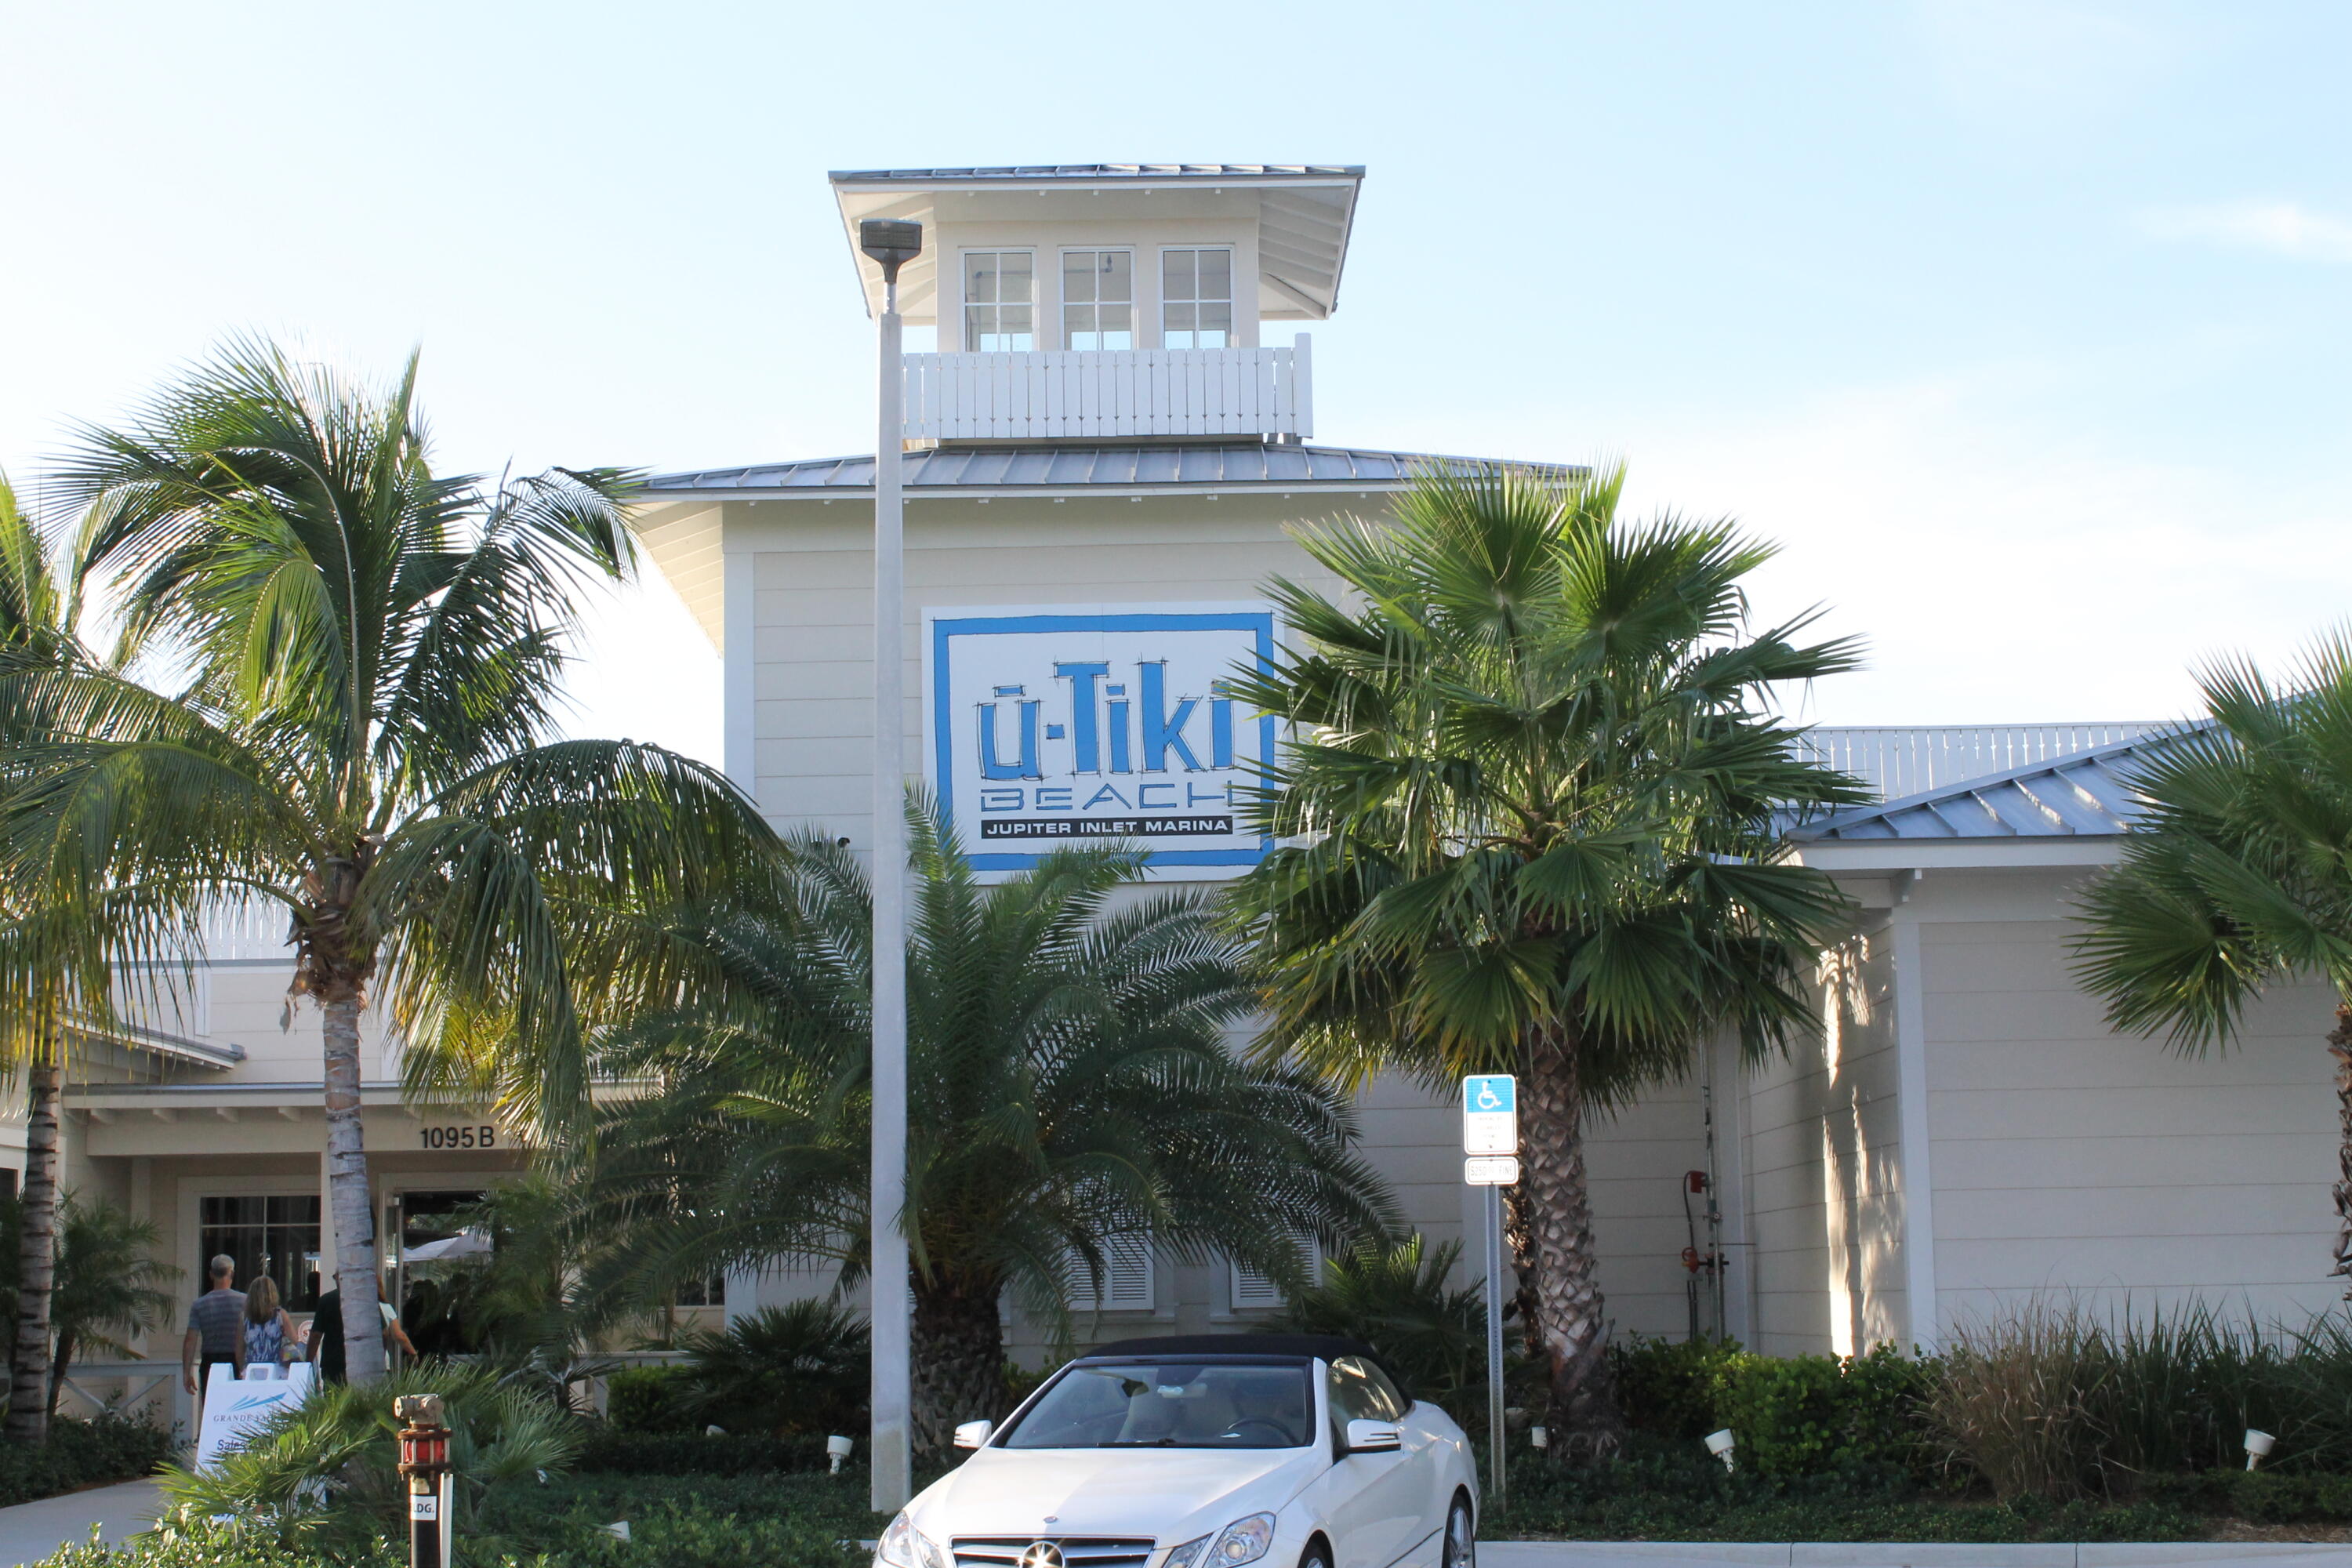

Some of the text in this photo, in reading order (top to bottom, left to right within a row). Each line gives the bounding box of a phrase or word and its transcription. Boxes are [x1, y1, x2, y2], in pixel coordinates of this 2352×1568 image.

[981, 780, 1233, 812] BEACH
[986, 820, 1229, 836] JUPITER INLET MARINA
